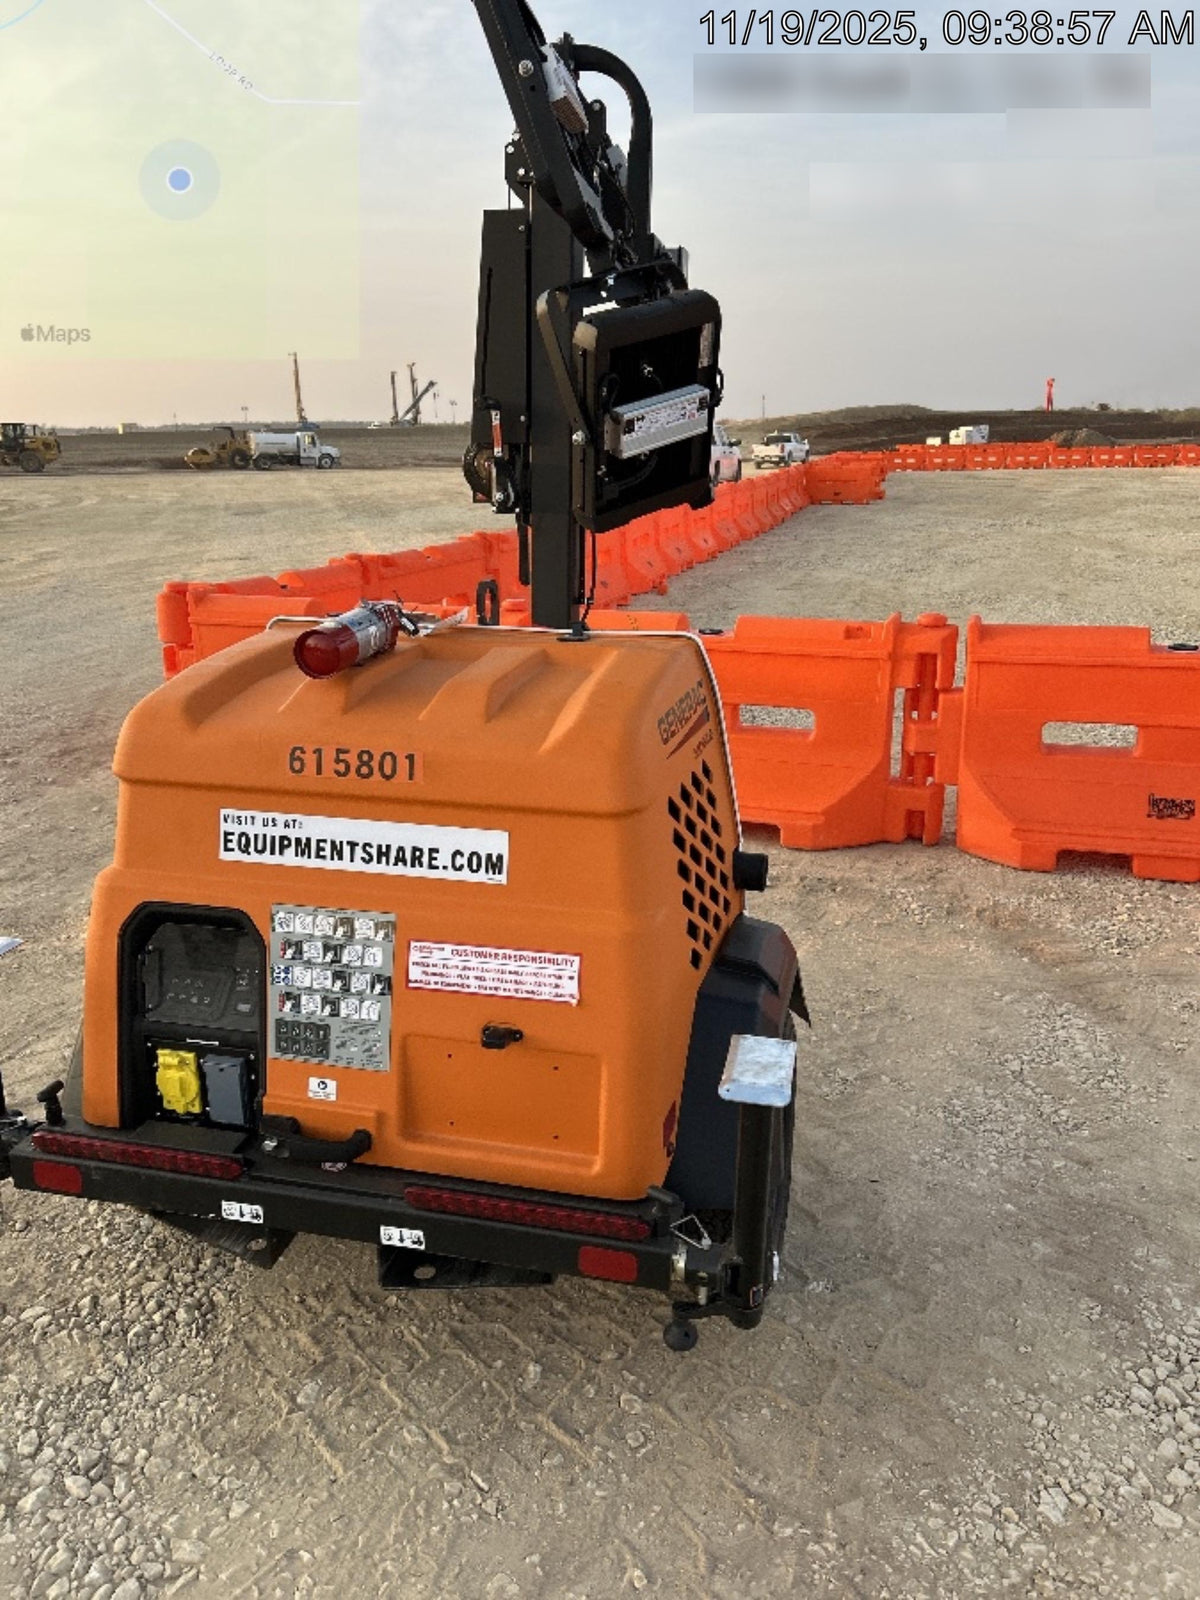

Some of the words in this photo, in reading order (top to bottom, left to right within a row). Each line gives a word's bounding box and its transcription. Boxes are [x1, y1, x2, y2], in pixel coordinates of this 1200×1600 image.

[288, 745, 416, 782] 615801
[223, 813, 256, 826] VISIT
[262, 817, 278, 828] US
[283, 819, 304, 830] AT:
[223, 829, 504, 876] EQUIPMENTSHARE.COM
